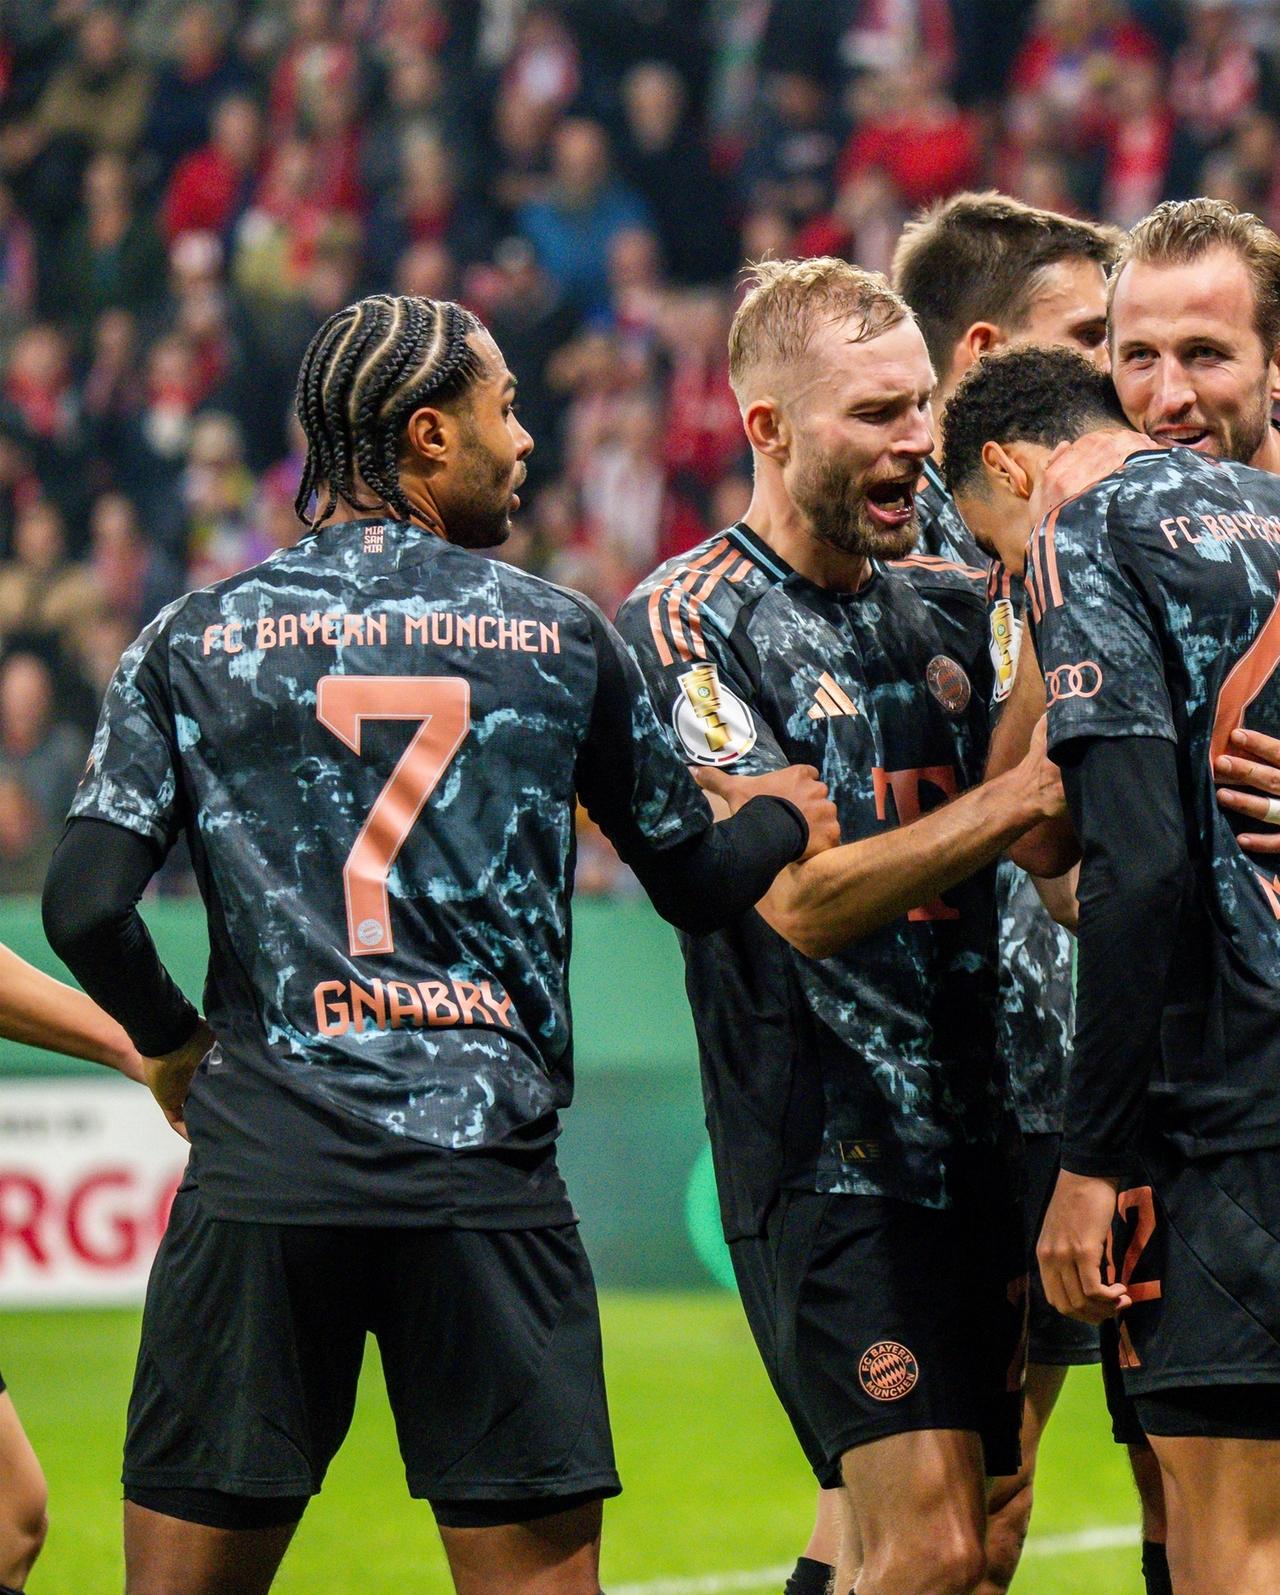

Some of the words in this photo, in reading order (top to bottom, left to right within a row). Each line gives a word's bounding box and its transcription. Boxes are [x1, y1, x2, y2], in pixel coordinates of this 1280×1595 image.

[364, 535, 384, 544] SAN
[365, 526, 384, 535] MIA
[1160, 516, 1200, 549] FC
[363, 544, 383, 553] MIA
[203, 624, 243, 656] FC
[257, 613, 388, 650] BAYERN
[404, 612, 561, 655] MÜNCHEN
[317, 675, 470, 957] 7
[314, 978, 512, 1036] GNABRY
[1106, 1185, 1162, 1302] 2
[862, 1357, 872, 1372] FC
[870, 1344, 913, 1364] BAYERN
